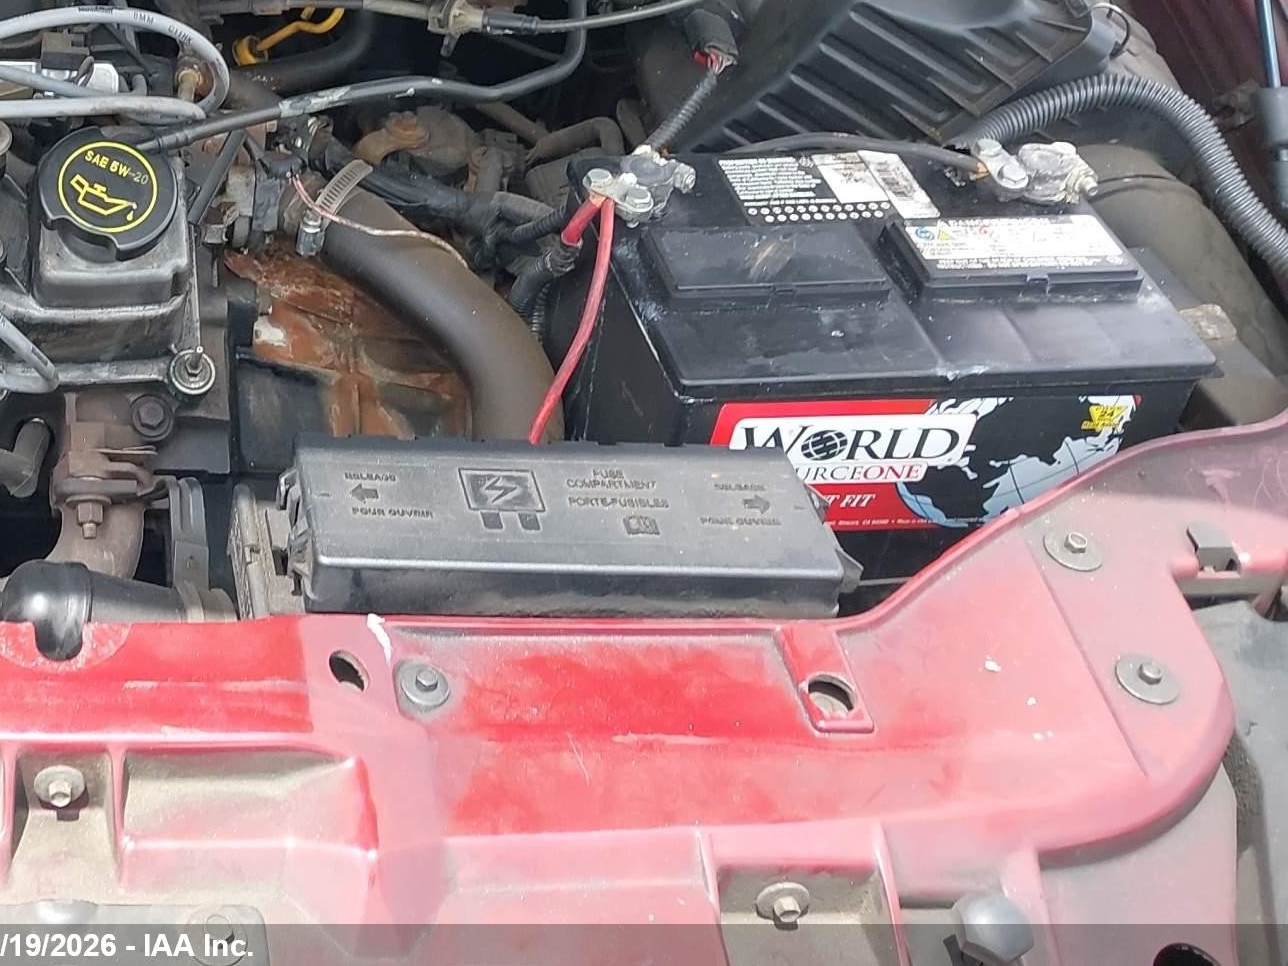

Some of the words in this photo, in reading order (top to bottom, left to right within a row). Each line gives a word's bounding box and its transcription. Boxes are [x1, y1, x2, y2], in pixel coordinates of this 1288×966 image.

[85, 150, 110, 169] SAE
[110, 160, 149, 185] 5W-20
[737, 423, 961, 462] WORLD
[796, 464, 922, 483] URCEONE
[839, 493, 875, 508] FIT
